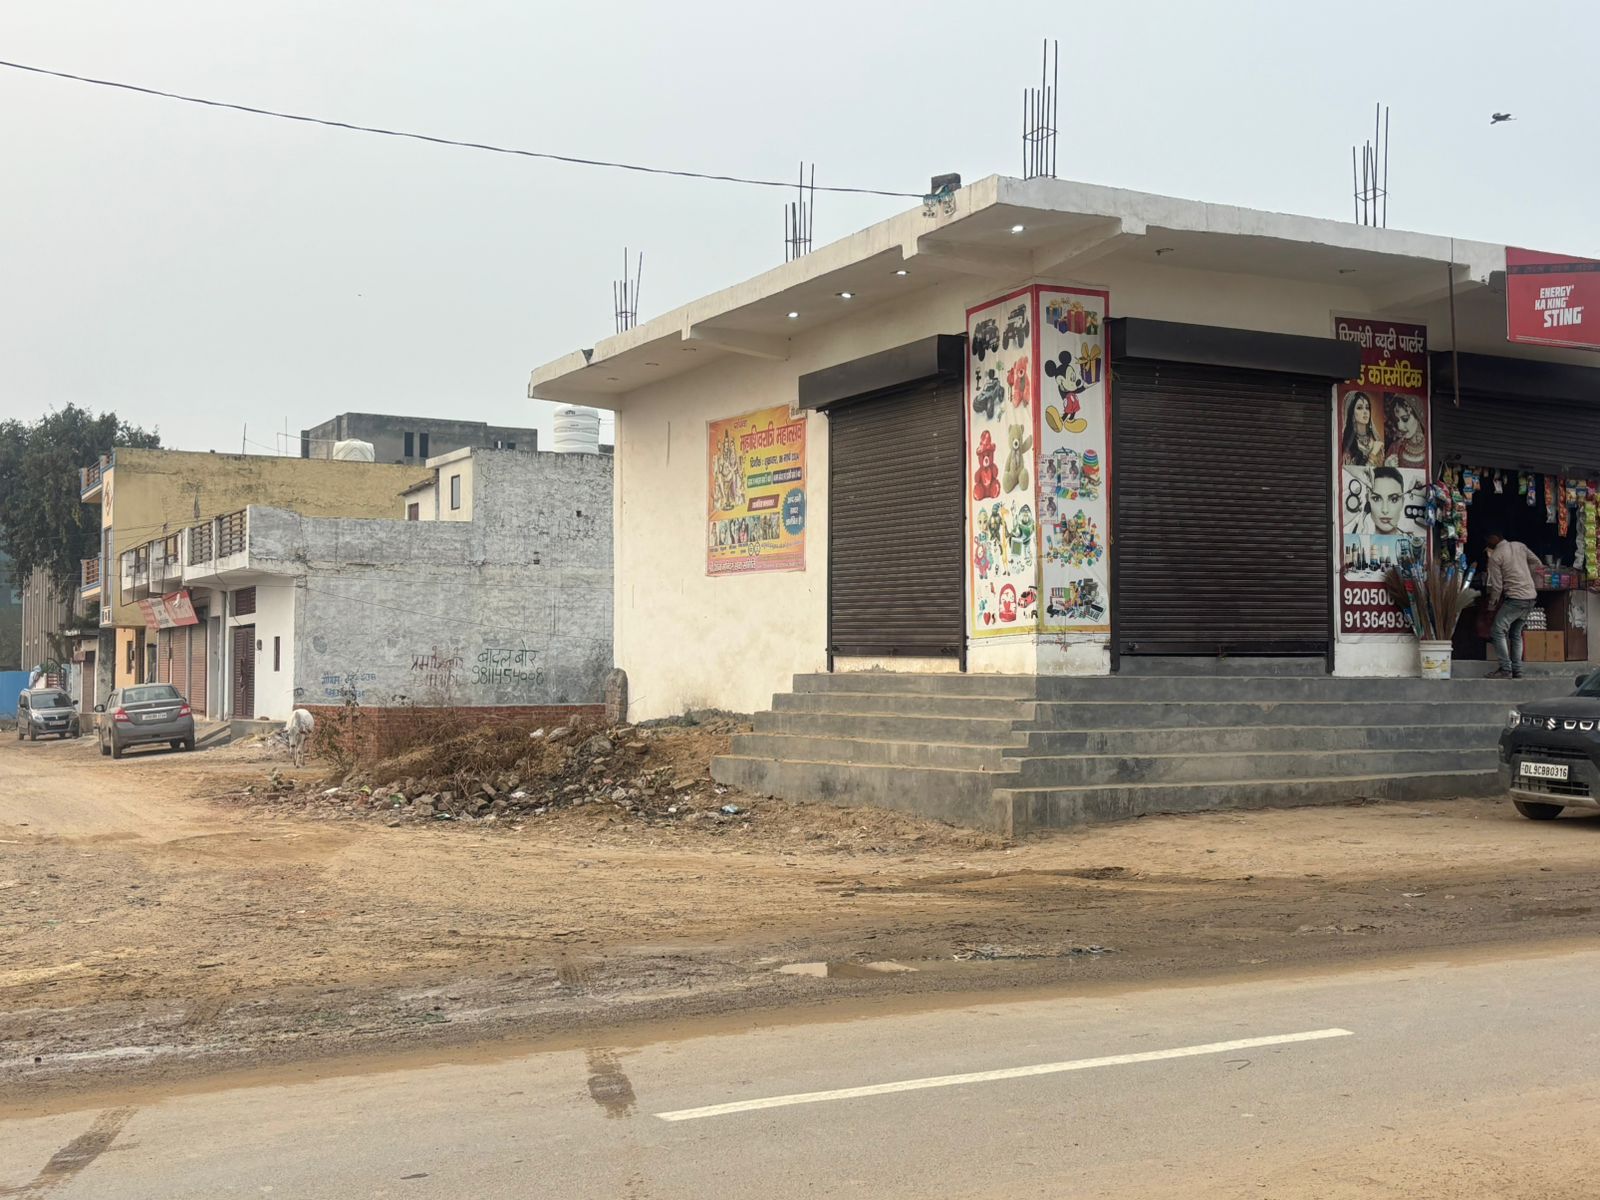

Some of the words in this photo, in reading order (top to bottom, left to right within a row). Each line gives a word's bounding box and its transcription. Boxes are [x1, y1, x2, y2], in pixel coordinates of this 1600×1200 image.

[1540, 285, 1572, 299] ENERGY
[1535, 299, 1546, 311] KA
[1547, 297, 1566, 309] KING
[1544, 307, 1582, 328] STING
[471, 665, 545, 686] 9811454008
